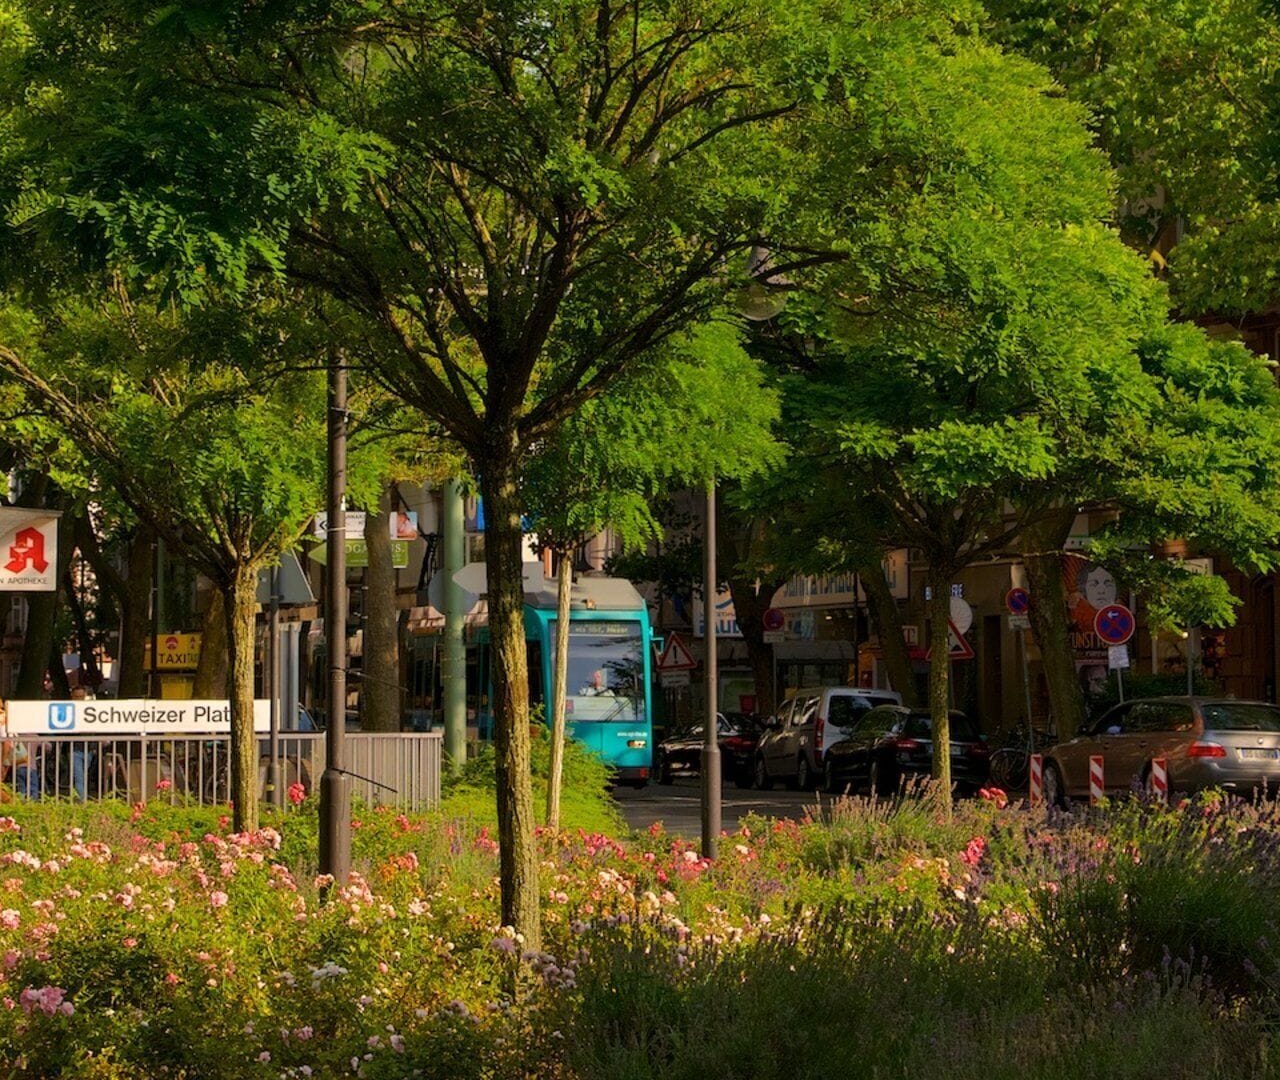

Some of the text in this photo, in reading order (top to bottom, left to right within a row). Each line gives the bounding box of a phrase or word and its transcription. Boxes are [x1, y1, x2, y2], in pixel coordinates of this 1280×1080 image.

[7, 577, 48, 585] APOTHEKE
[158, 653, 187, 664] TAXI
[83, 705, 187, 724] Schweizer
[194, 705, 231, 723] Plat
